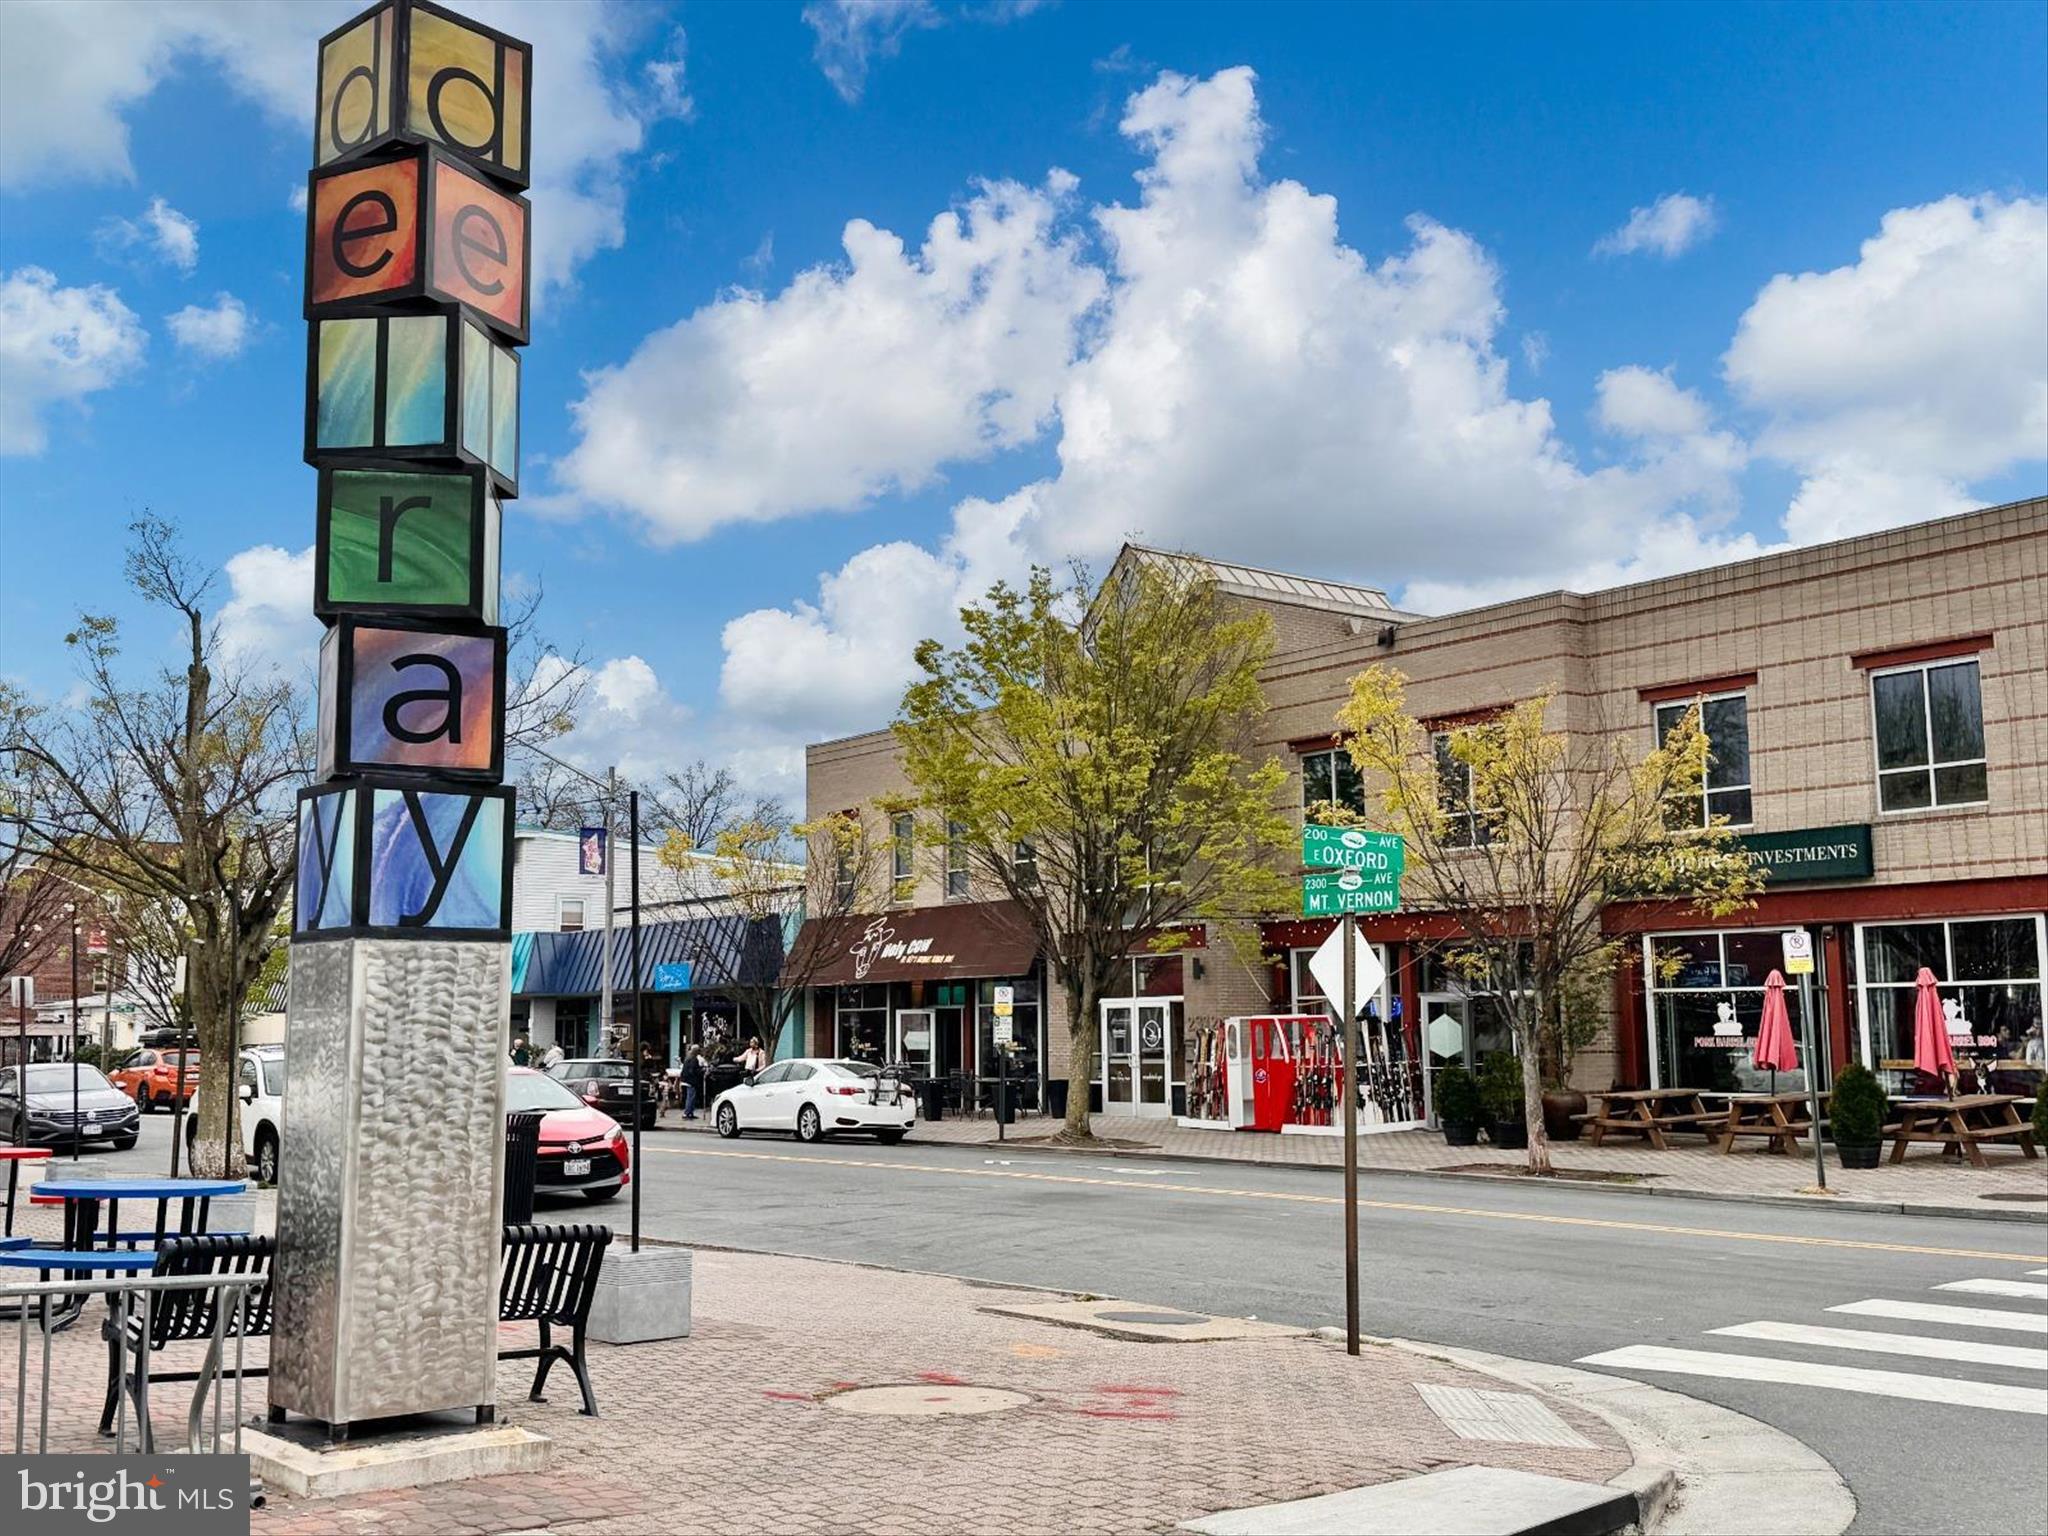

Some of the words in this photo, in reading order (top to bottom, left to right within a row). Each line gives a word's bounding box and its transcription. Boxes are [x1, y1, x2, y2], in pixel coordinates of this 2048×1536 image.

[1304, 828, 1328, 840] 200
[1379, 837, 1399, 849] AVE
[1314, 849, 1321, 861] E
[1323, 846, 1388, 869] OXFORD
[1747, 843, 1859, 866] INVESTMENTS
[1305, 878, 1327, 890] 2300
[1374, 873, 1393, 884] AVE
[1309, 894, 1331, 910] MT.
[1337, 890, 1393, 909] VERNON
